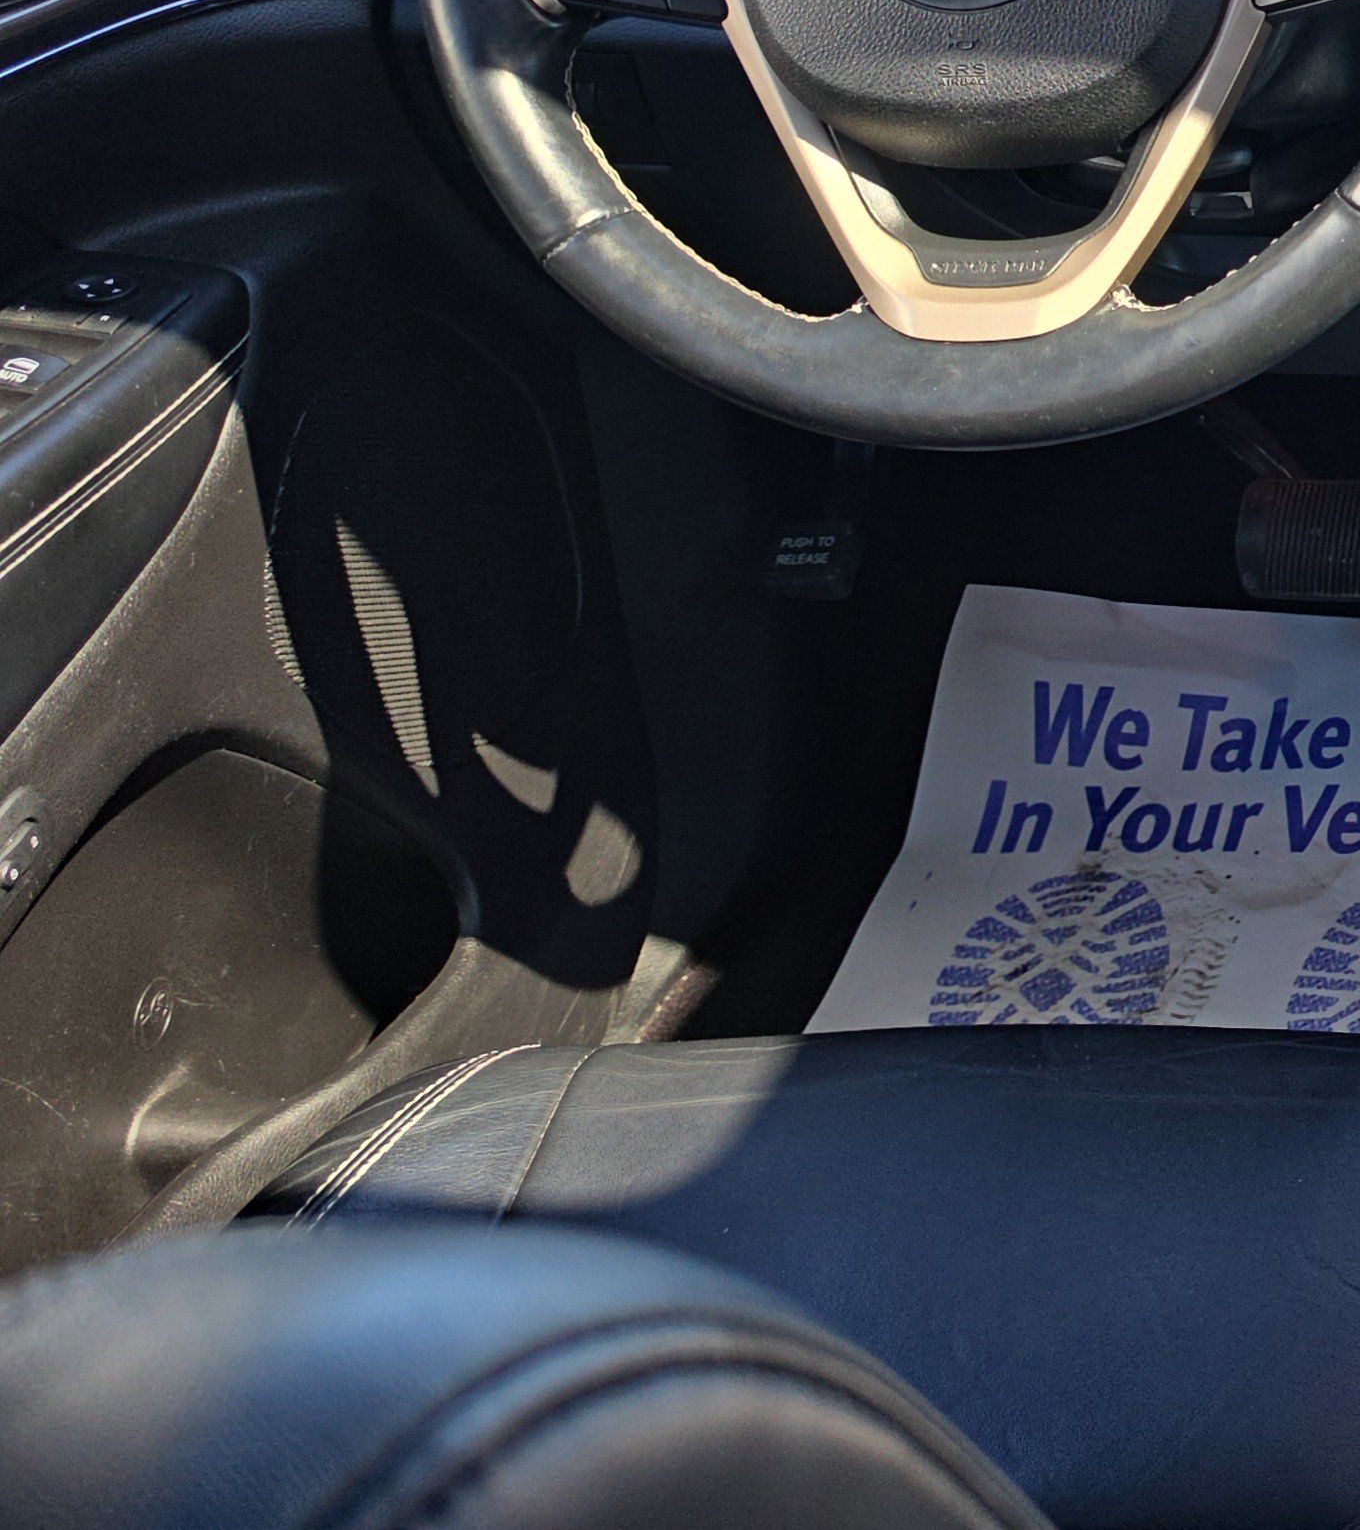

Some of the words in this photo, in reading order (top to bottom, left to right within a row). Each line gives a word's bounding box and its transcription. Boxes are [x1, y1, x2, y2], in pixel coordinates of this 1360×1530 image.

[938, 63, 987, 75] SRS
[780, 537, 815, 548] PUSH
[818, 535, 836, 547] TO
[775, 552, 830, 565] RELEASE
[1033, 681, 1150, 771] We
[1177, 693, 1351, 772] Take
[971, 778, 1055, 854] In
[1083, 785, 1263, 854] Your
